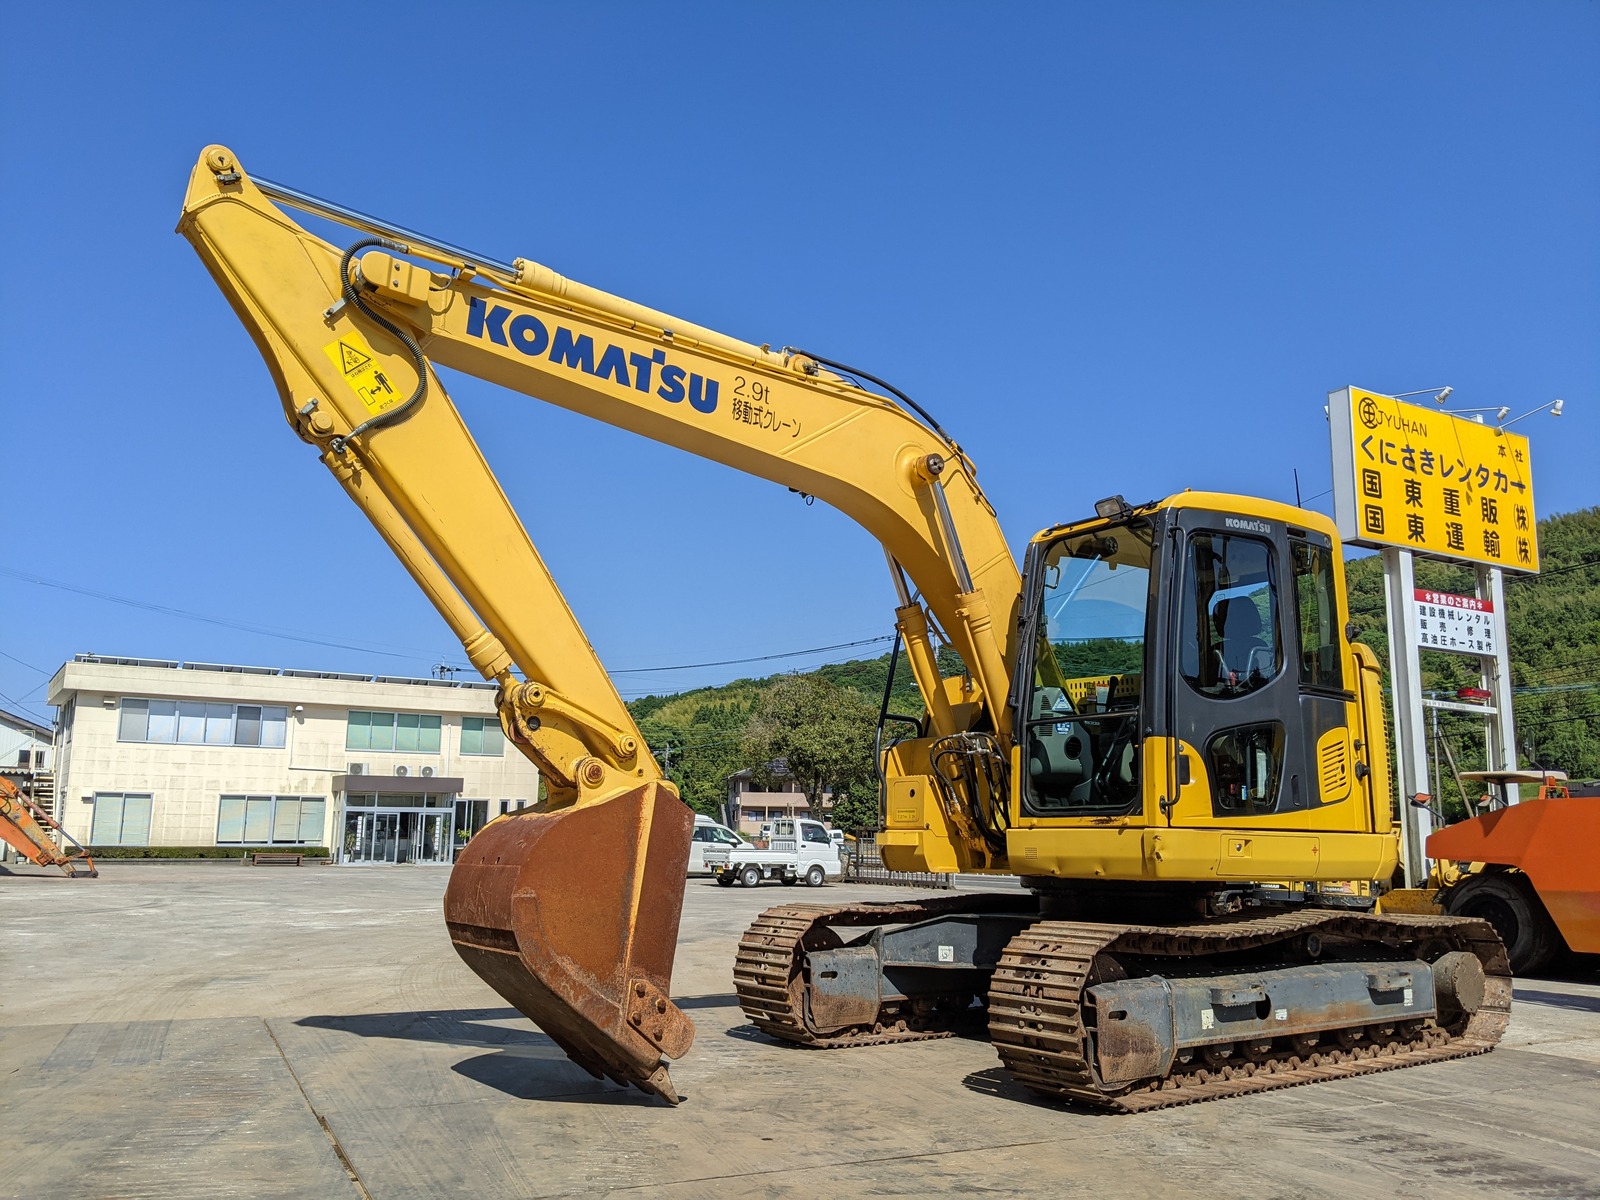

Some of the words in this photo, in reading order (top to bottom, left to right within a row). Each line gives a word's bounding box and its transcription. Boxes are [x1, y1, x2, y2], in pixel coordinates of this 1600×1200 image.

[466, 296, 720, 414] KOMATSU
[733, 376, 770, 405] 2.9t
[732, 398, 802, 438] 移動式クレーン
[1361, 435, 1526, 494] くにさきレンタカー
[1225, 518, 1271, 533] KOMATSU
[1419, 605, 1490, 626] 建設機械レンタル
